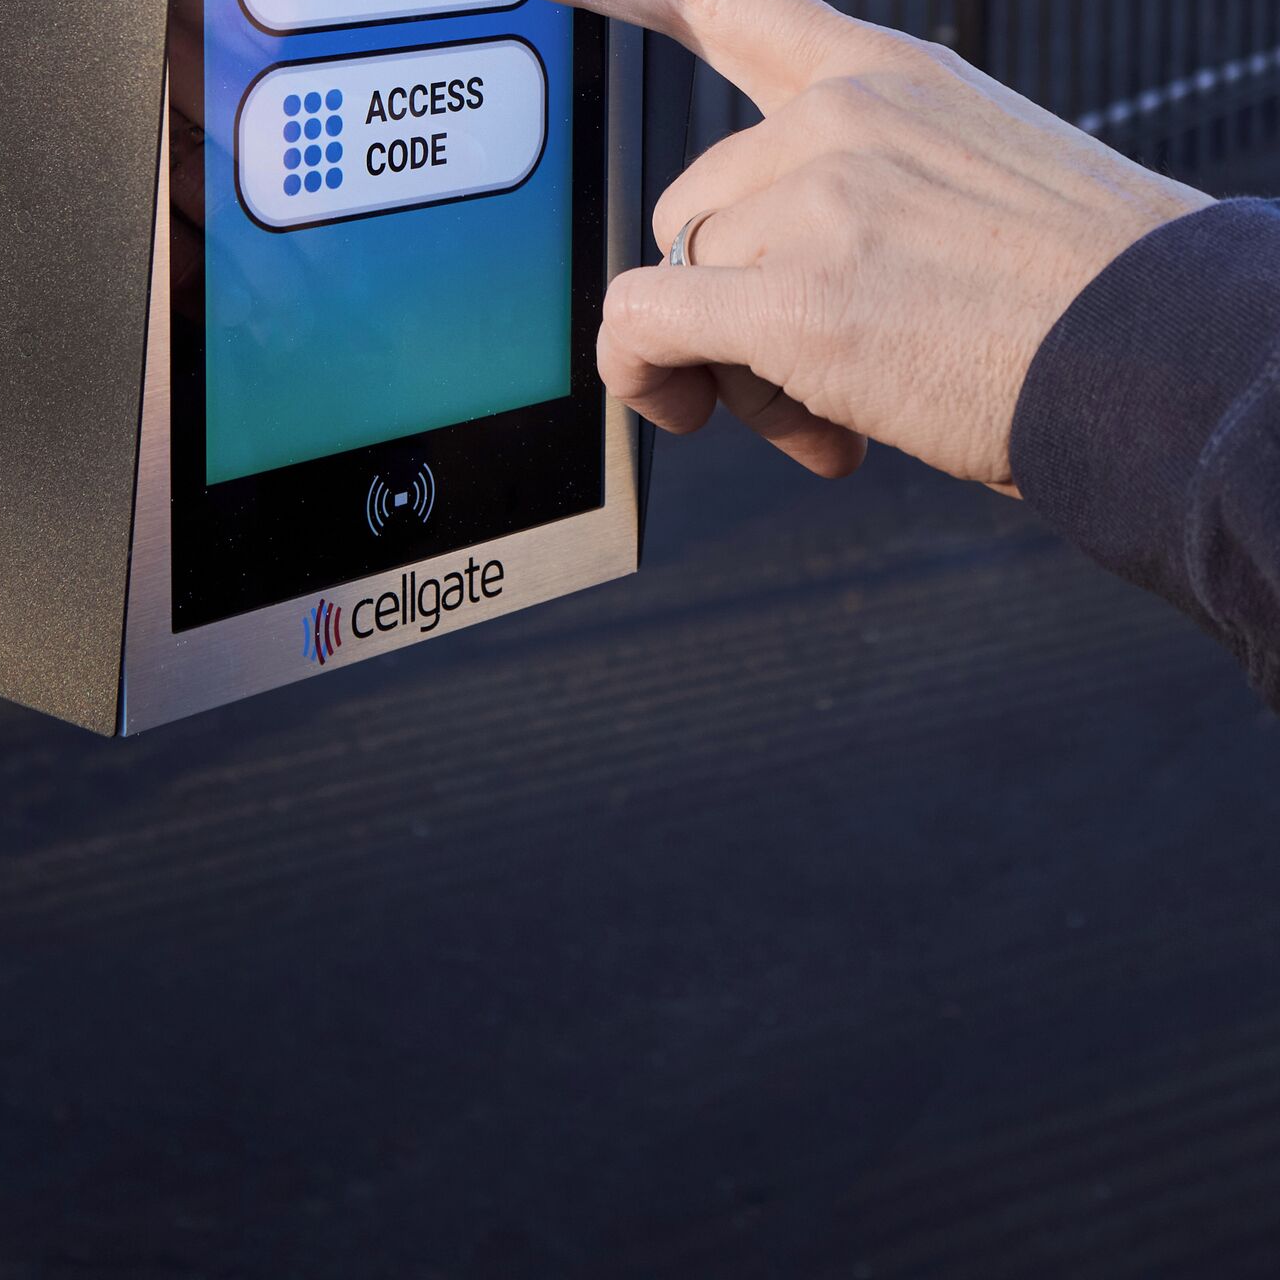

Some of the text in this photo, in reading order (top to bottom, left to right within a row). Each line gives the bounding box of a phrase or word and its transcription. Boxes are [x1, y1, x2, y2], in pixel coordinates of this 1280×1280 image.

[365, 76, 484, 125] ACCESS
[366, 132, 447, 176] CODE
[351, 556, 505, 639] cellgate
